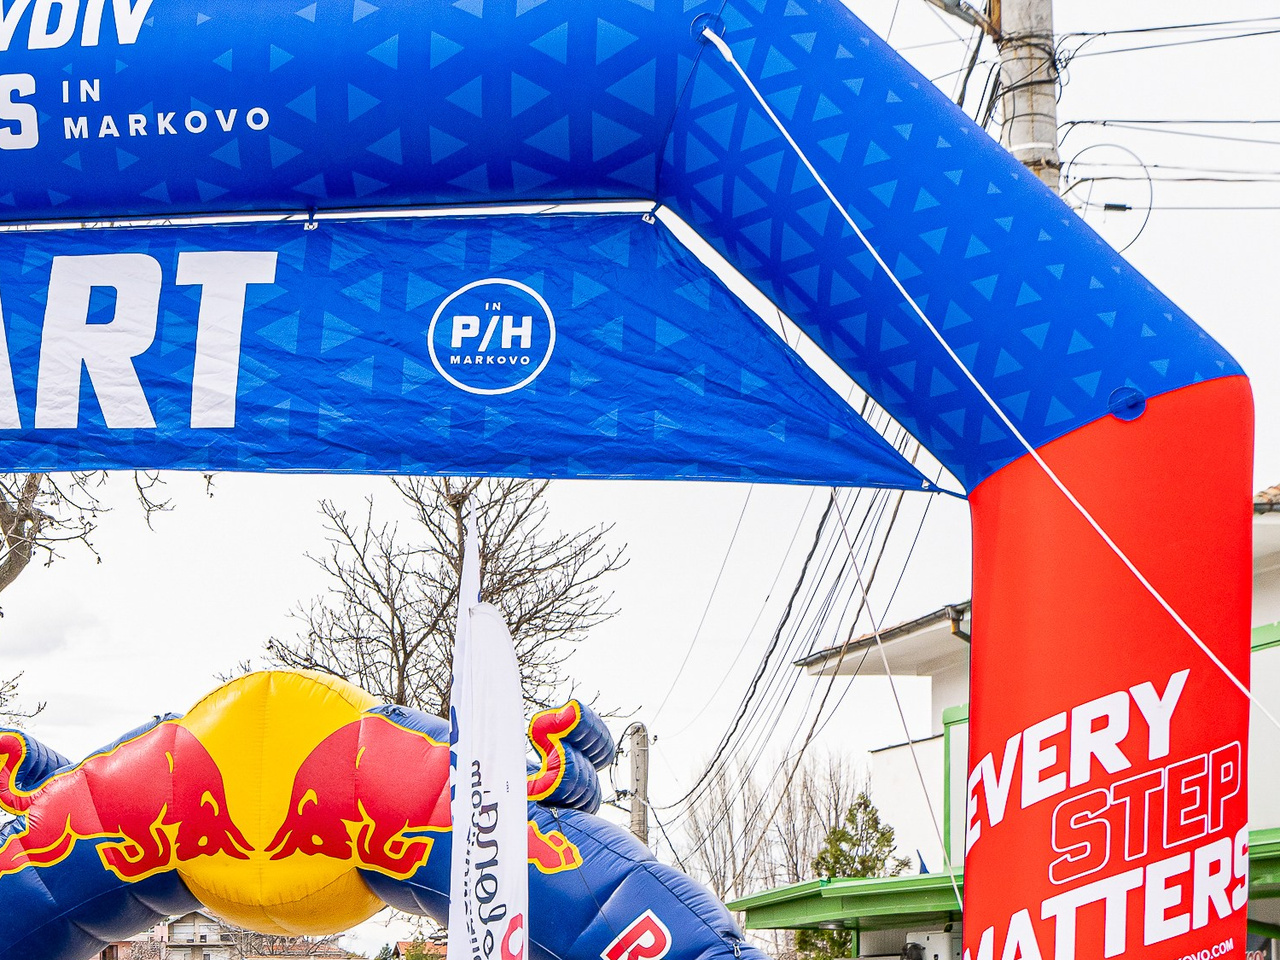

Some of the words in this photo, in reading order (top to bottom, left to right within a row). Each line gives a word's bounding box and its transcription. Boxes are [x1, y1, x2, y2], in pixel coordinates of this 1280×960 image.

[63, 79, 101, 103] IN
[64, 107, 270, 139] MARKOVO
[484, 302, 501, 311] IN
[451, 315, 532, 352] P/H
[450, 355, 530, 365] MARKOVO
[966, 668, 1190, 857] EVERY
[1049, 741, 1241, 885] STEP
